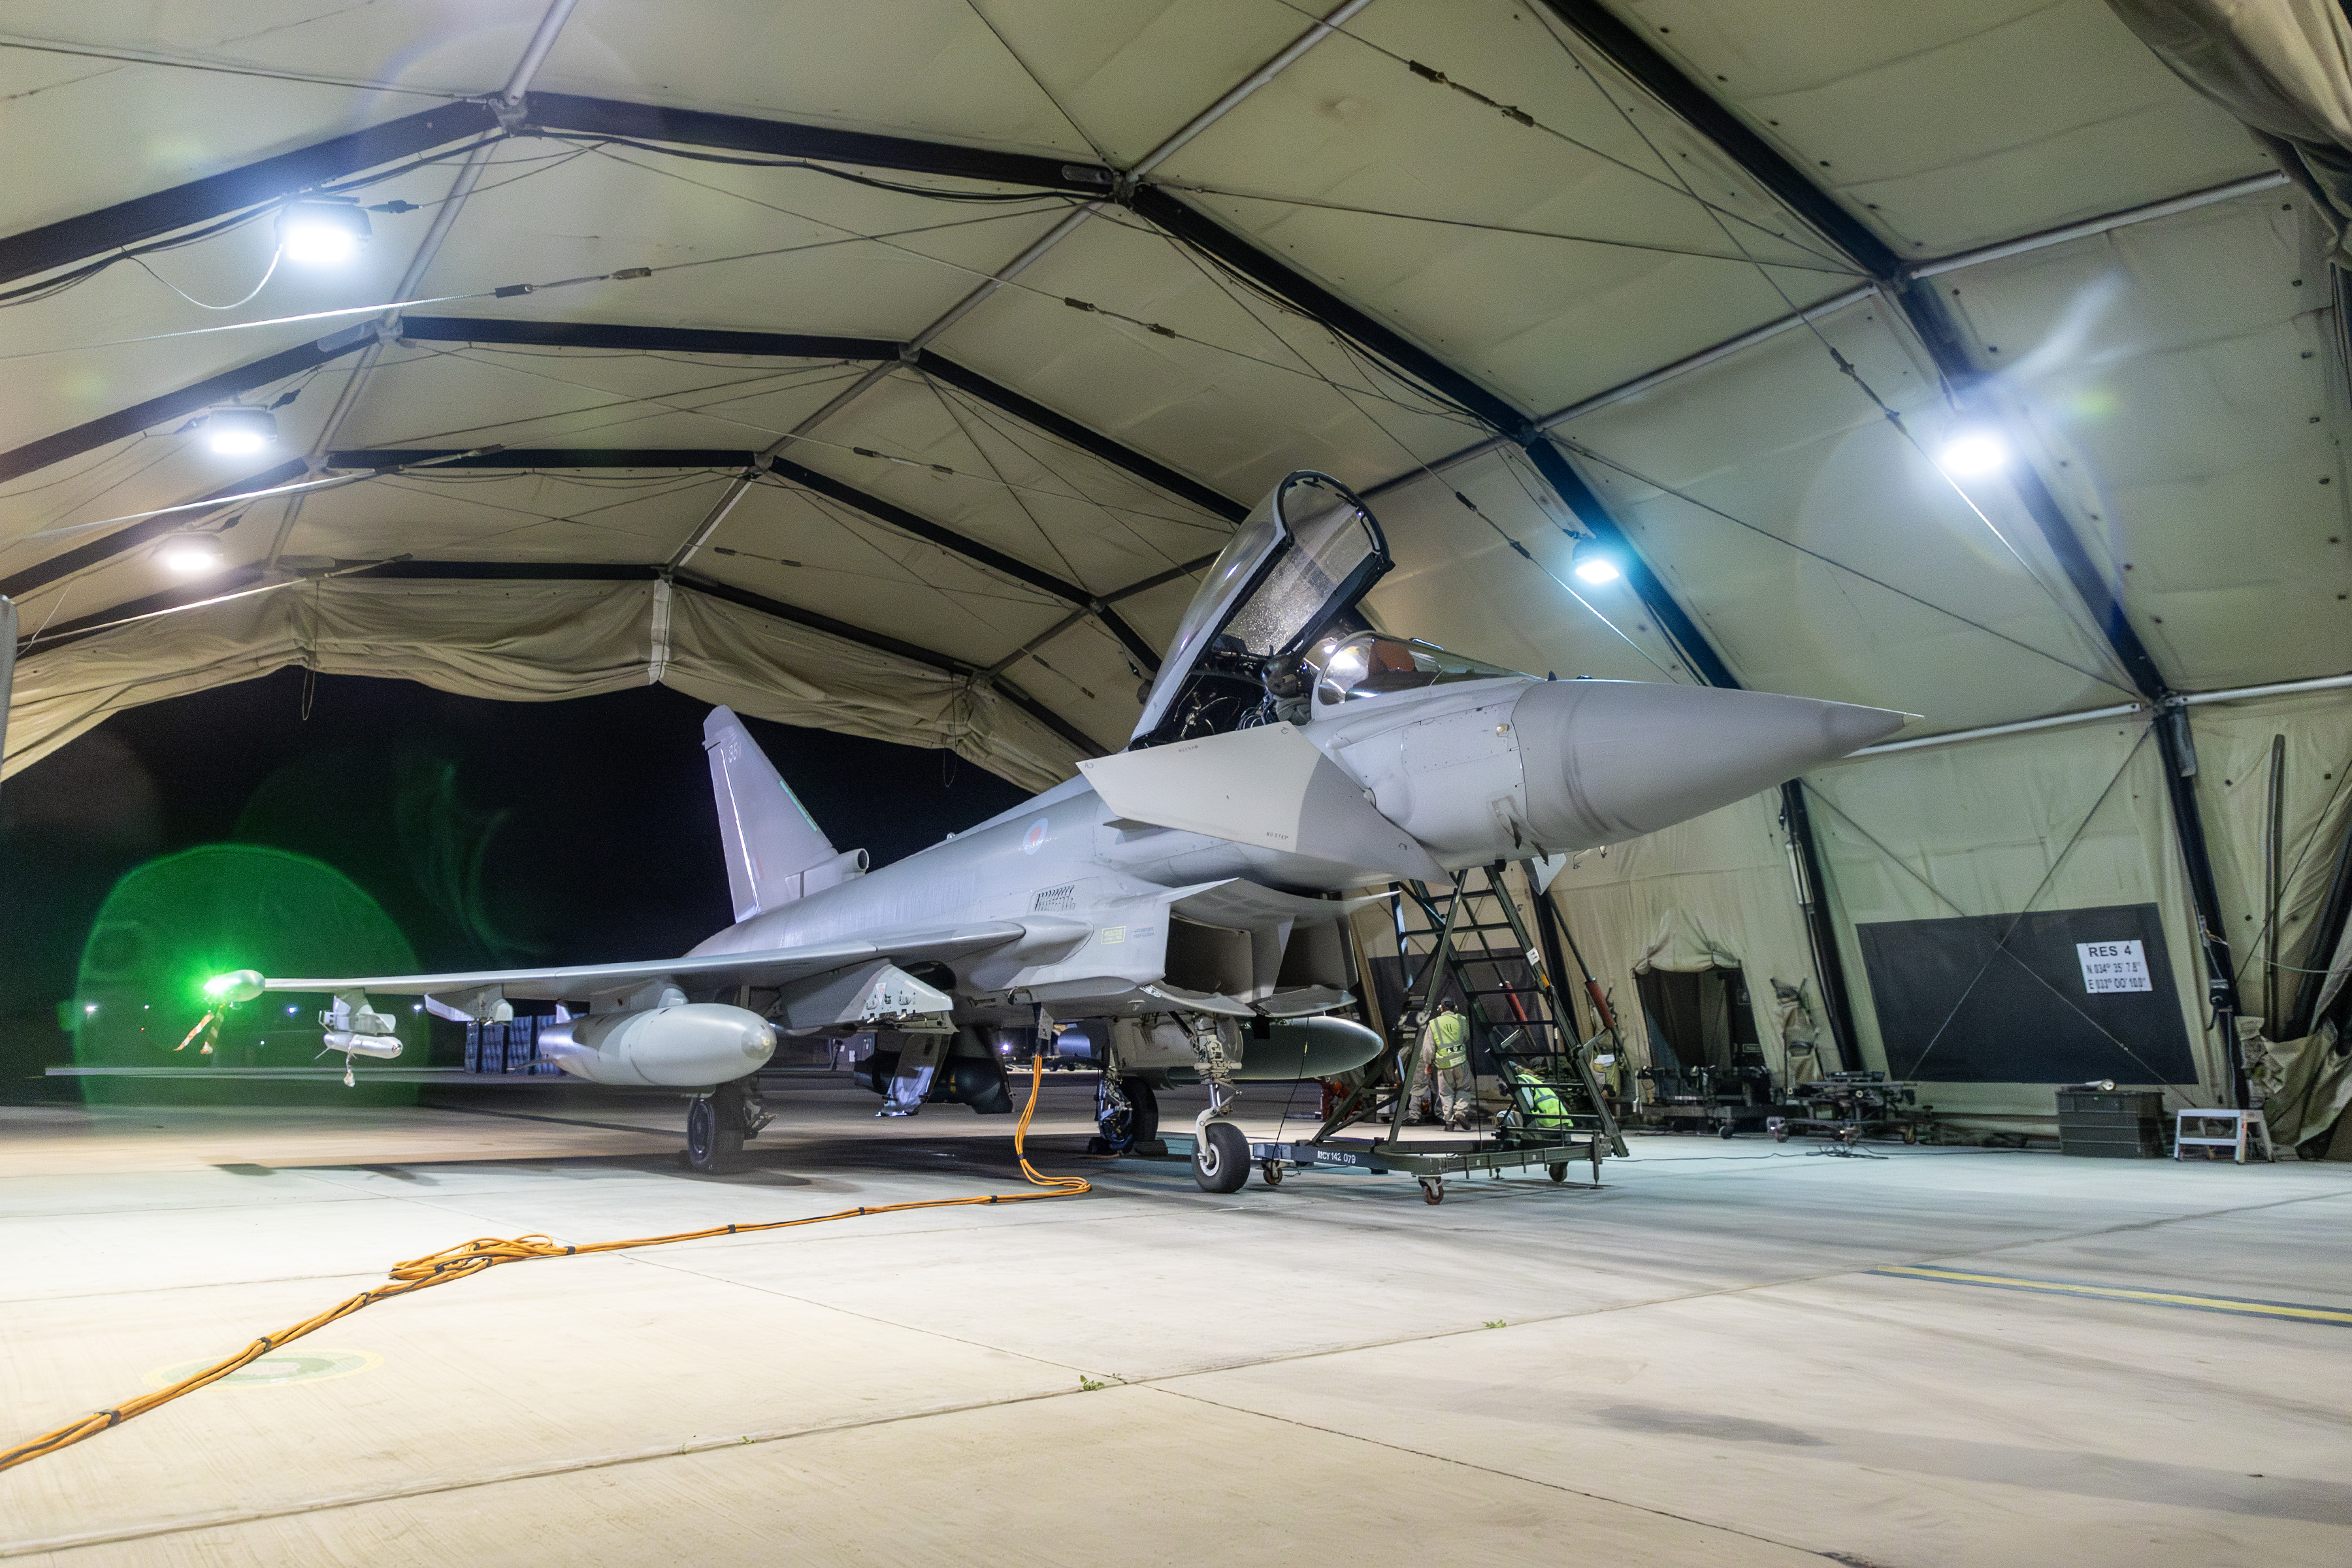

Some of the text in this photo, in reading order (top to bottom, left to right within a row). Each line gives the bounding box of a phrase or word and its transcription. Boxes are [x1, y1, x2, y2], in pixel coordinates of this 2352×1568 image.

[2088, 945, 2132, 957] RES 4
[2088, 979, 2095, 989] E
[1343, 1153, 1356, 1164] 079
